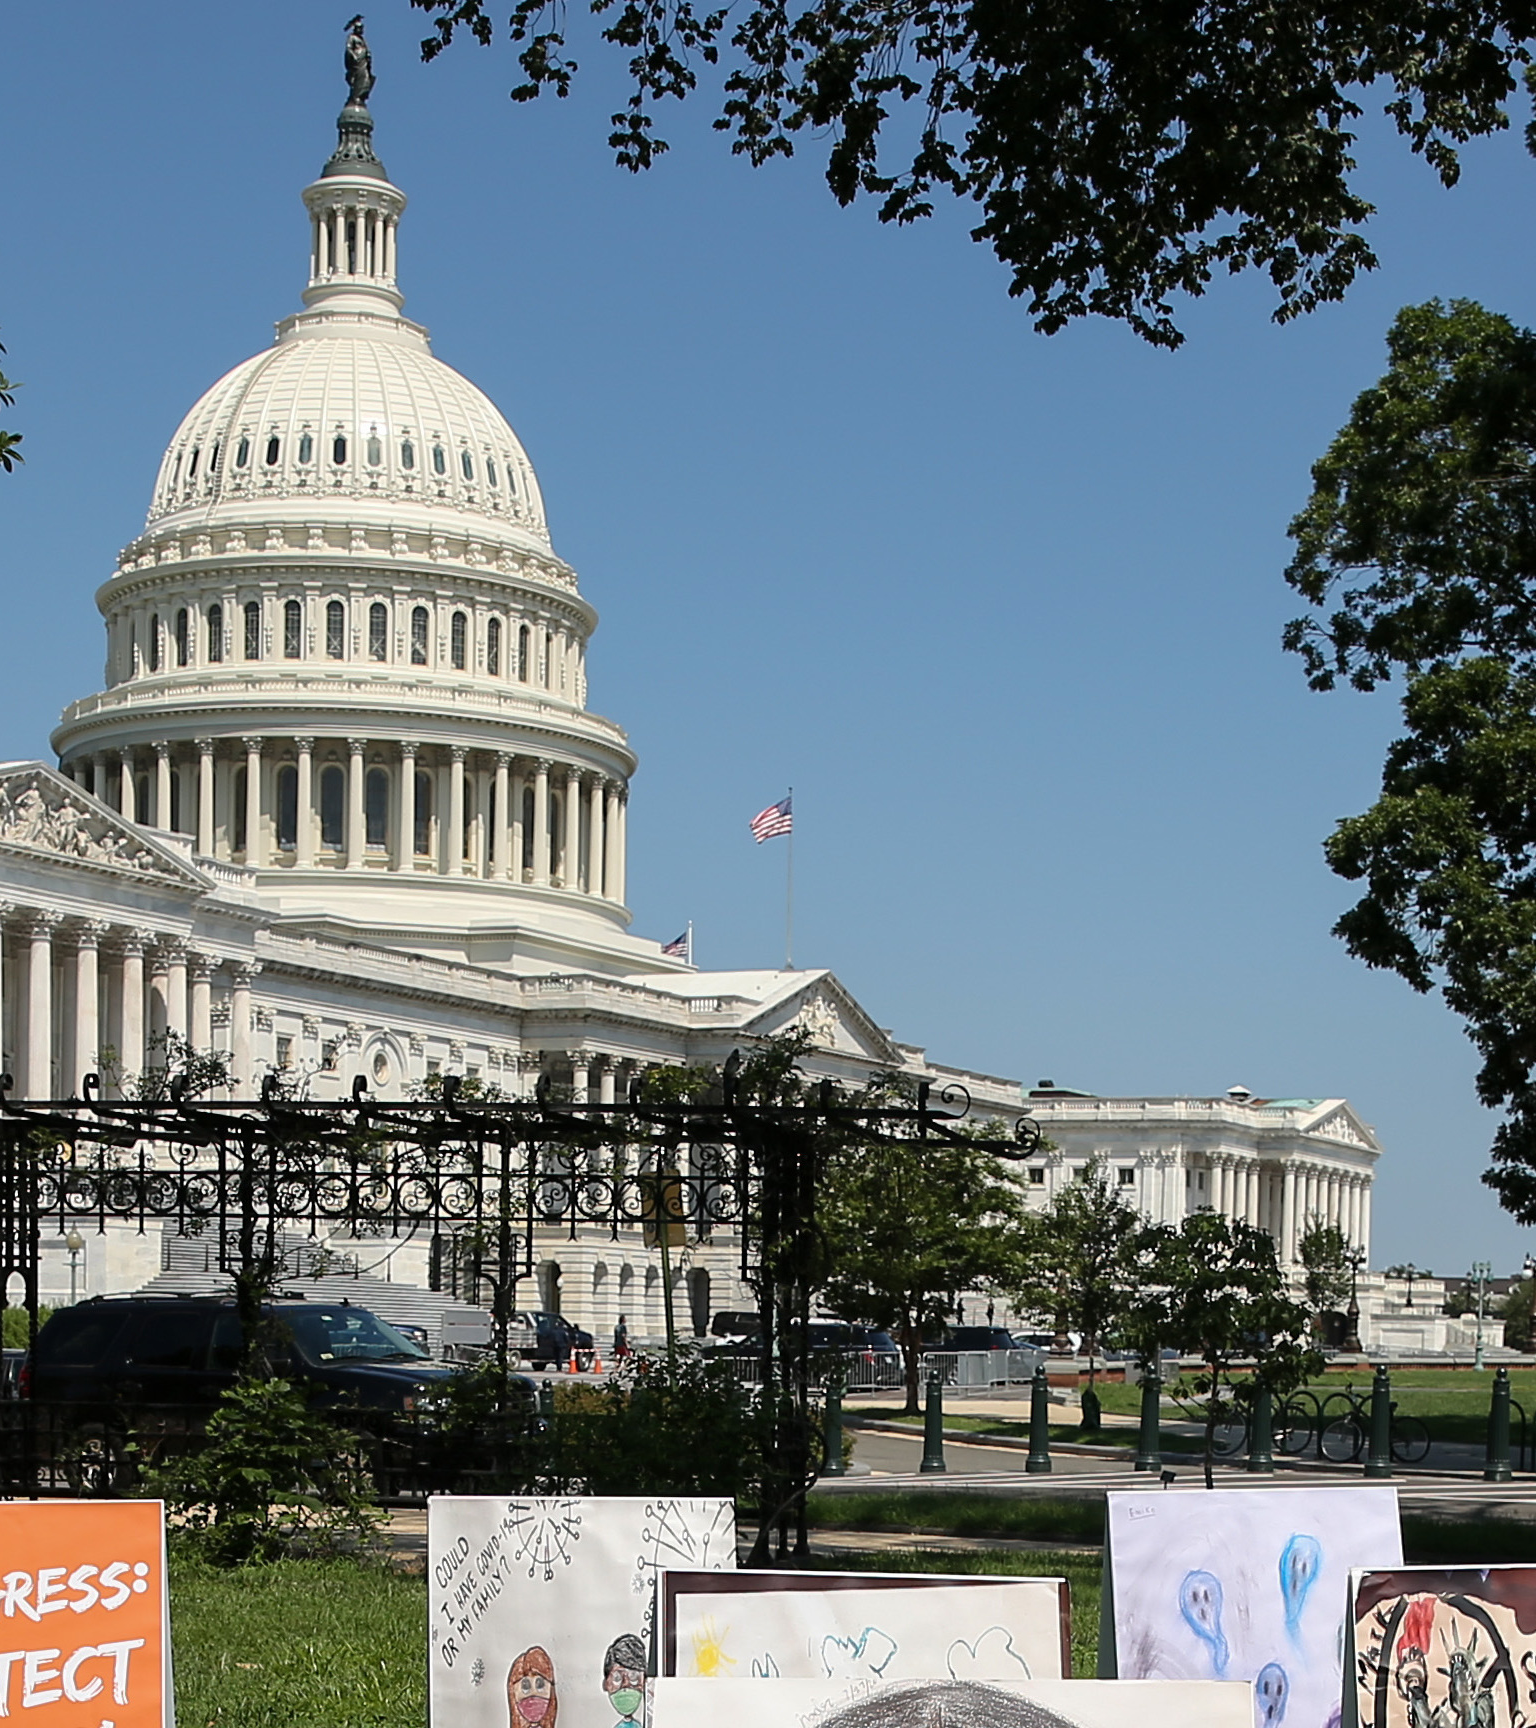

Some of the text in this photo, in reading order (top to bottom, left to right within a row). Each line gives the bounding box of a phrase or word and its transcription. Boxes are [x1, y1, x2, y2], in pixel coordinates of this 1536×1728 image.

[434, 1535, 470, 1589] COULD
[440, 1601, 455, 1625] I
[453, 1570, 478, 1609] HAVE
[441, 1637, 461, 1668] OR
[457, 1614, 474, 1642] MY
